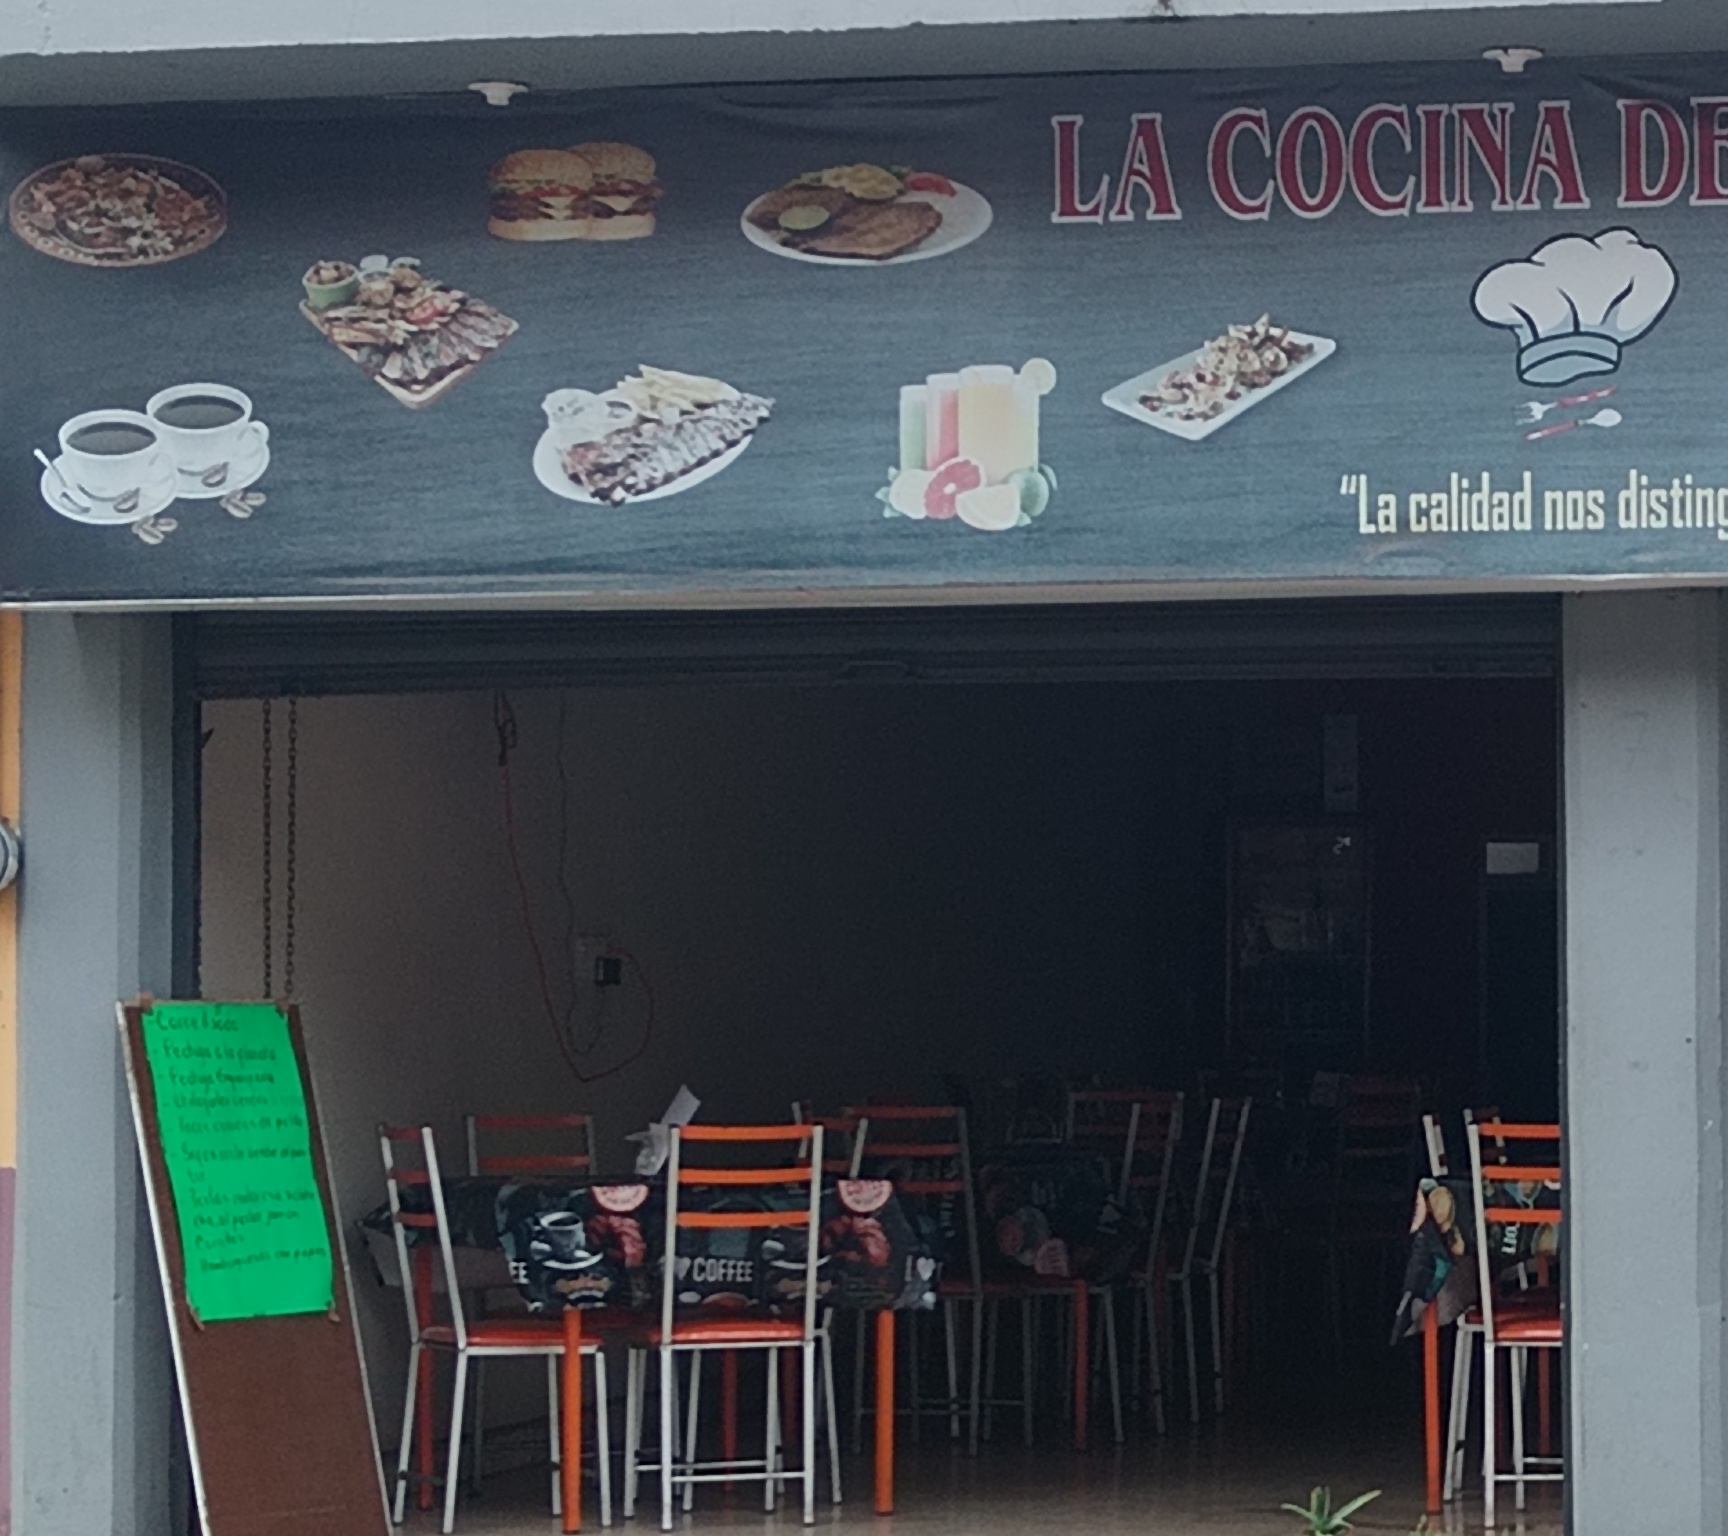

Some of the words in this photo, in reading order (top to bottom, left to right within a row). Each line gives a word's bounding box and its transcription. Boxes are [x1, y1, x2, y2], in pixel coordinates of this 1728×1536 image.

[1049, 113, 1182, 225] LA
[1206, 98, 1591, 224] COCINA
[1407, 471, 1534, 533] calidad
[1542, 481, 1607, 531] nos
[692, 1256, 754, 1283] COFFEE
